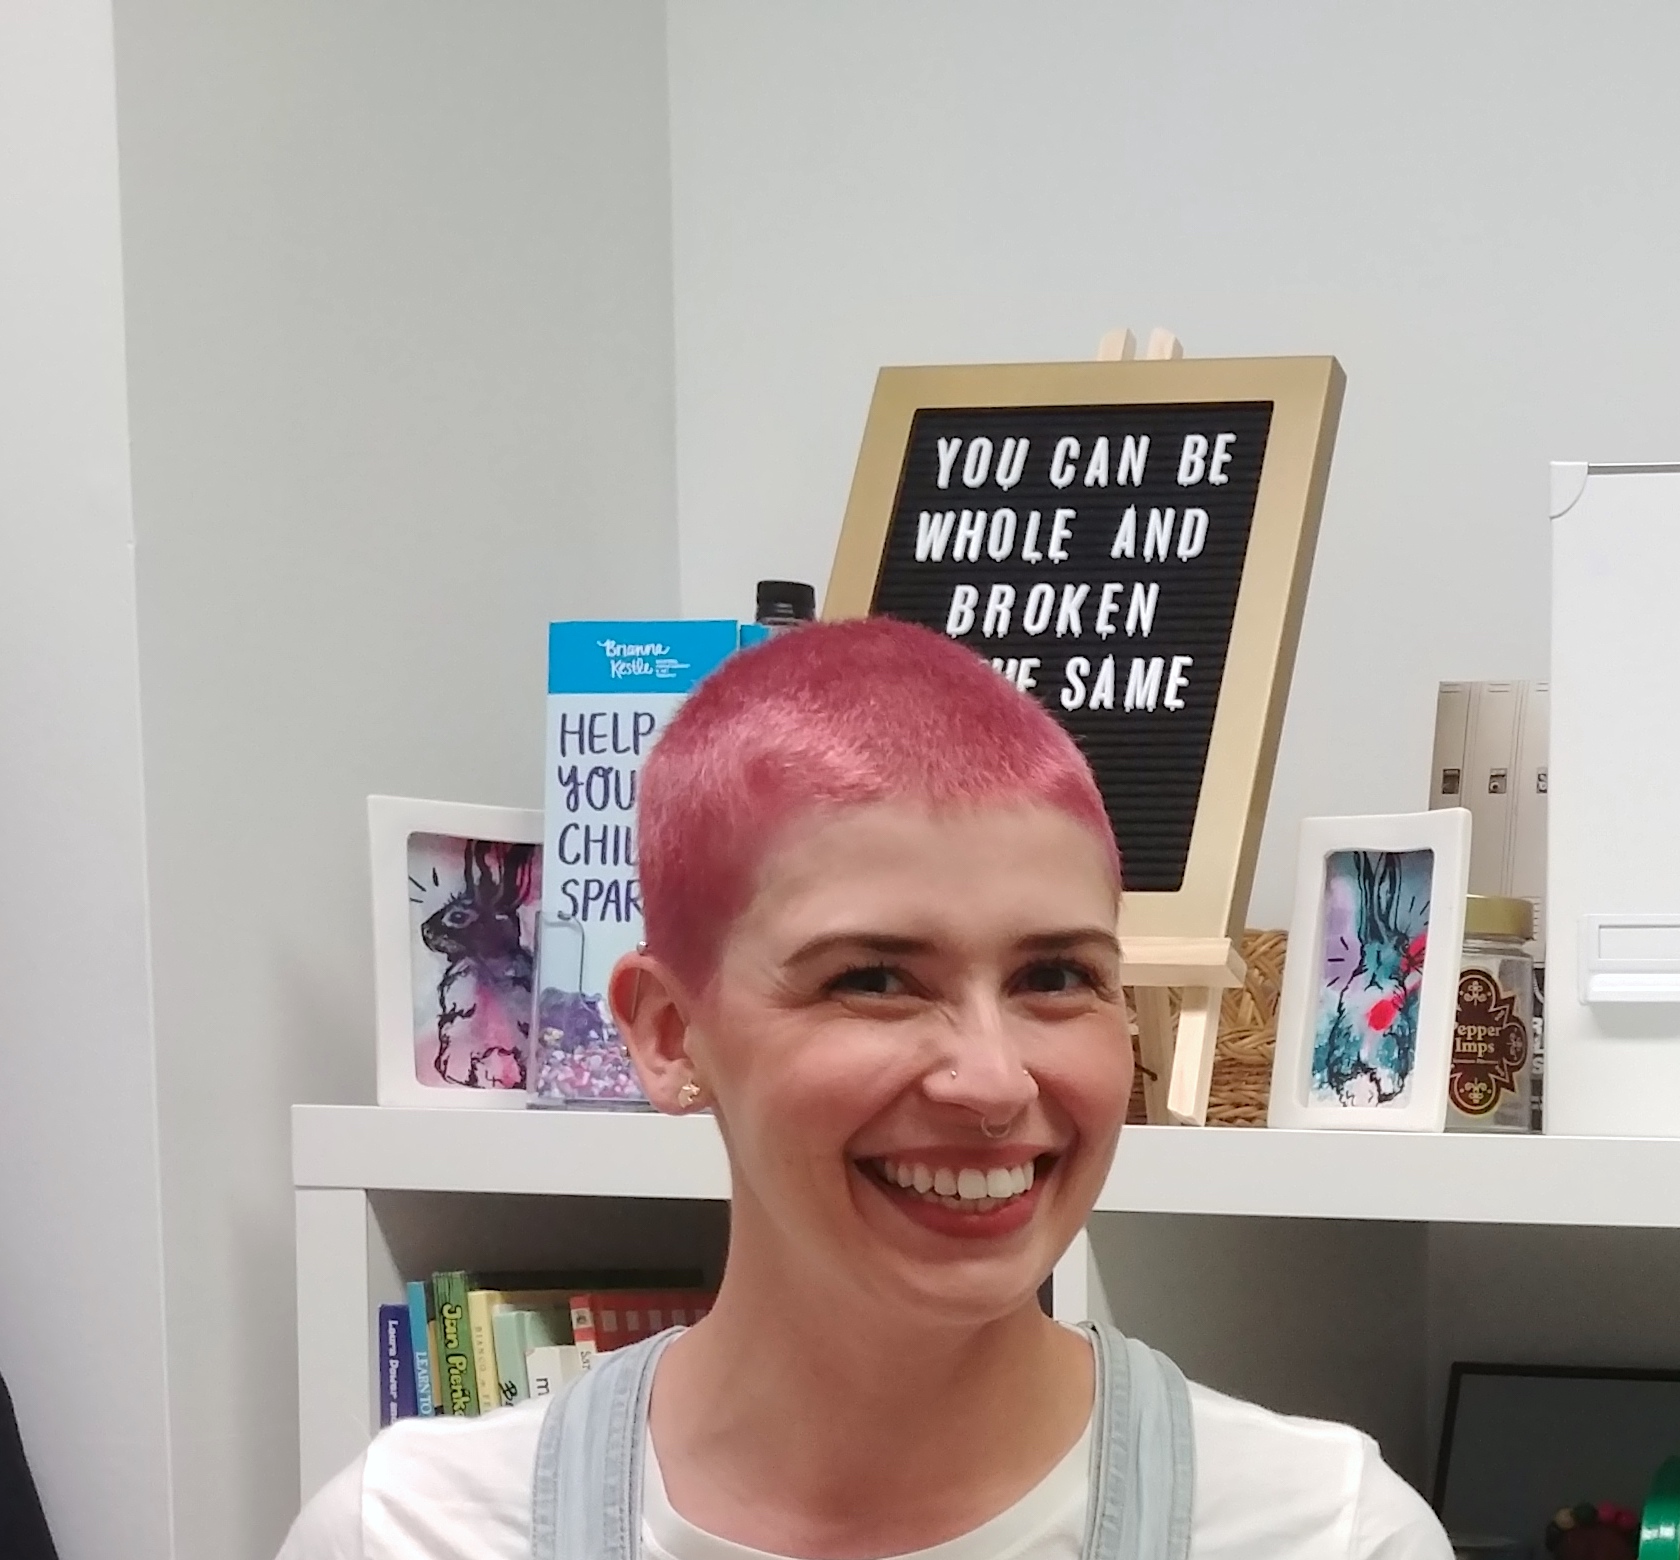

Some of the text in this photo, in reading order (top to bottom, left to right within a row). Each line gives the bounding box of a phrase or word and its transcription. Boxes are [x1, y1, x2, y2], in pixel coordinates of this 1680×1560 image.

[936, 432, 1237, 491] YOU CAN BE
[914, 503, 1209, 564] WHOLE AND
[945, 582, 1160, 640] BROKEN
[1060, 653, 1194, 712] SAME
[560, 711, 656, 757] HELP
[1455, 1037, 1495, 1057] Imps
[442, 1303, 462, 1349] Jan
[416, 1351, 433, 1414] LEARN TO
